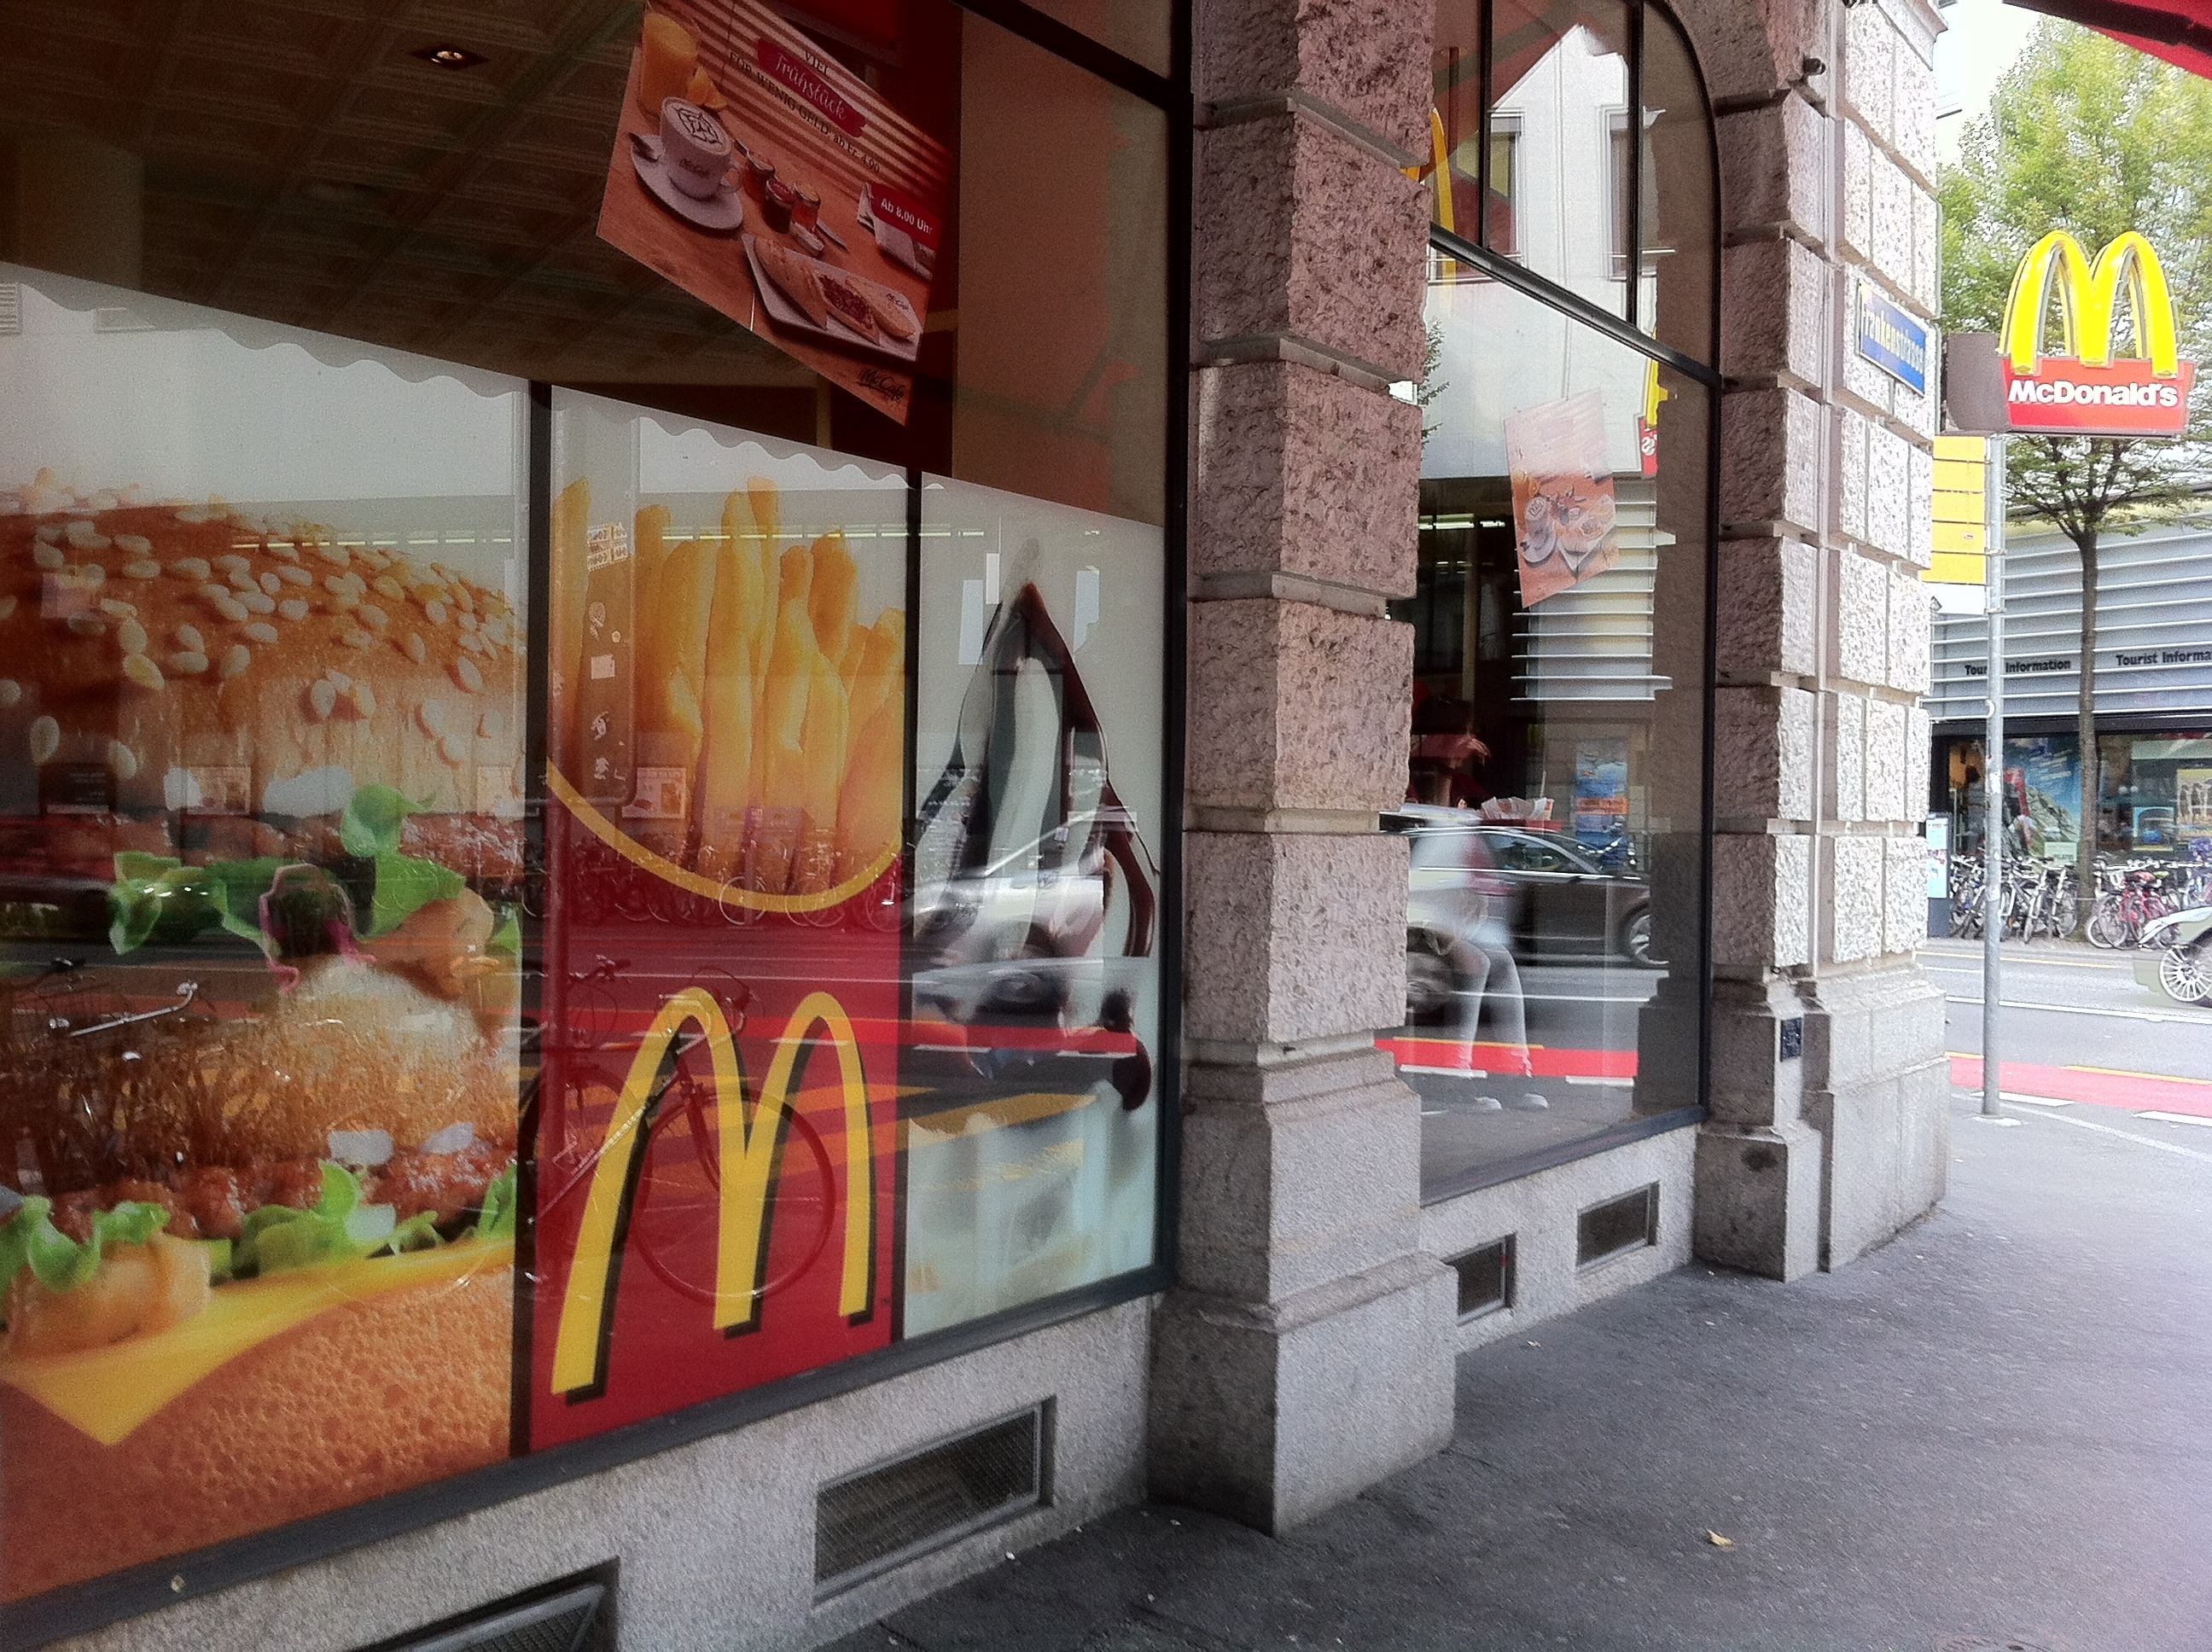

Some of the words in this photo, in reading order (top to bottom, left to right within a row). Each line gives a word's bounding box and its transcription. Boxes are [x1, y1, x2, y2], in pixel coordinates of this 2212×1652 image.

[804, 50, 830, 79] VIEL
[756, 72, 795, 111] WENIG
[776, 52, 847, 120] Frühstück
[881, 198, 894, 213] Ab
[896, 206, 915, 225] 8.00
[917, 218, 933, 235] Uhr
[2008, 380, 2179, 407] McDonald's
[2005, 659, 2071, 673] Information
[2116, 653, 2157, 666] Tourist
[2163, 650, 2212, 663] Informa
